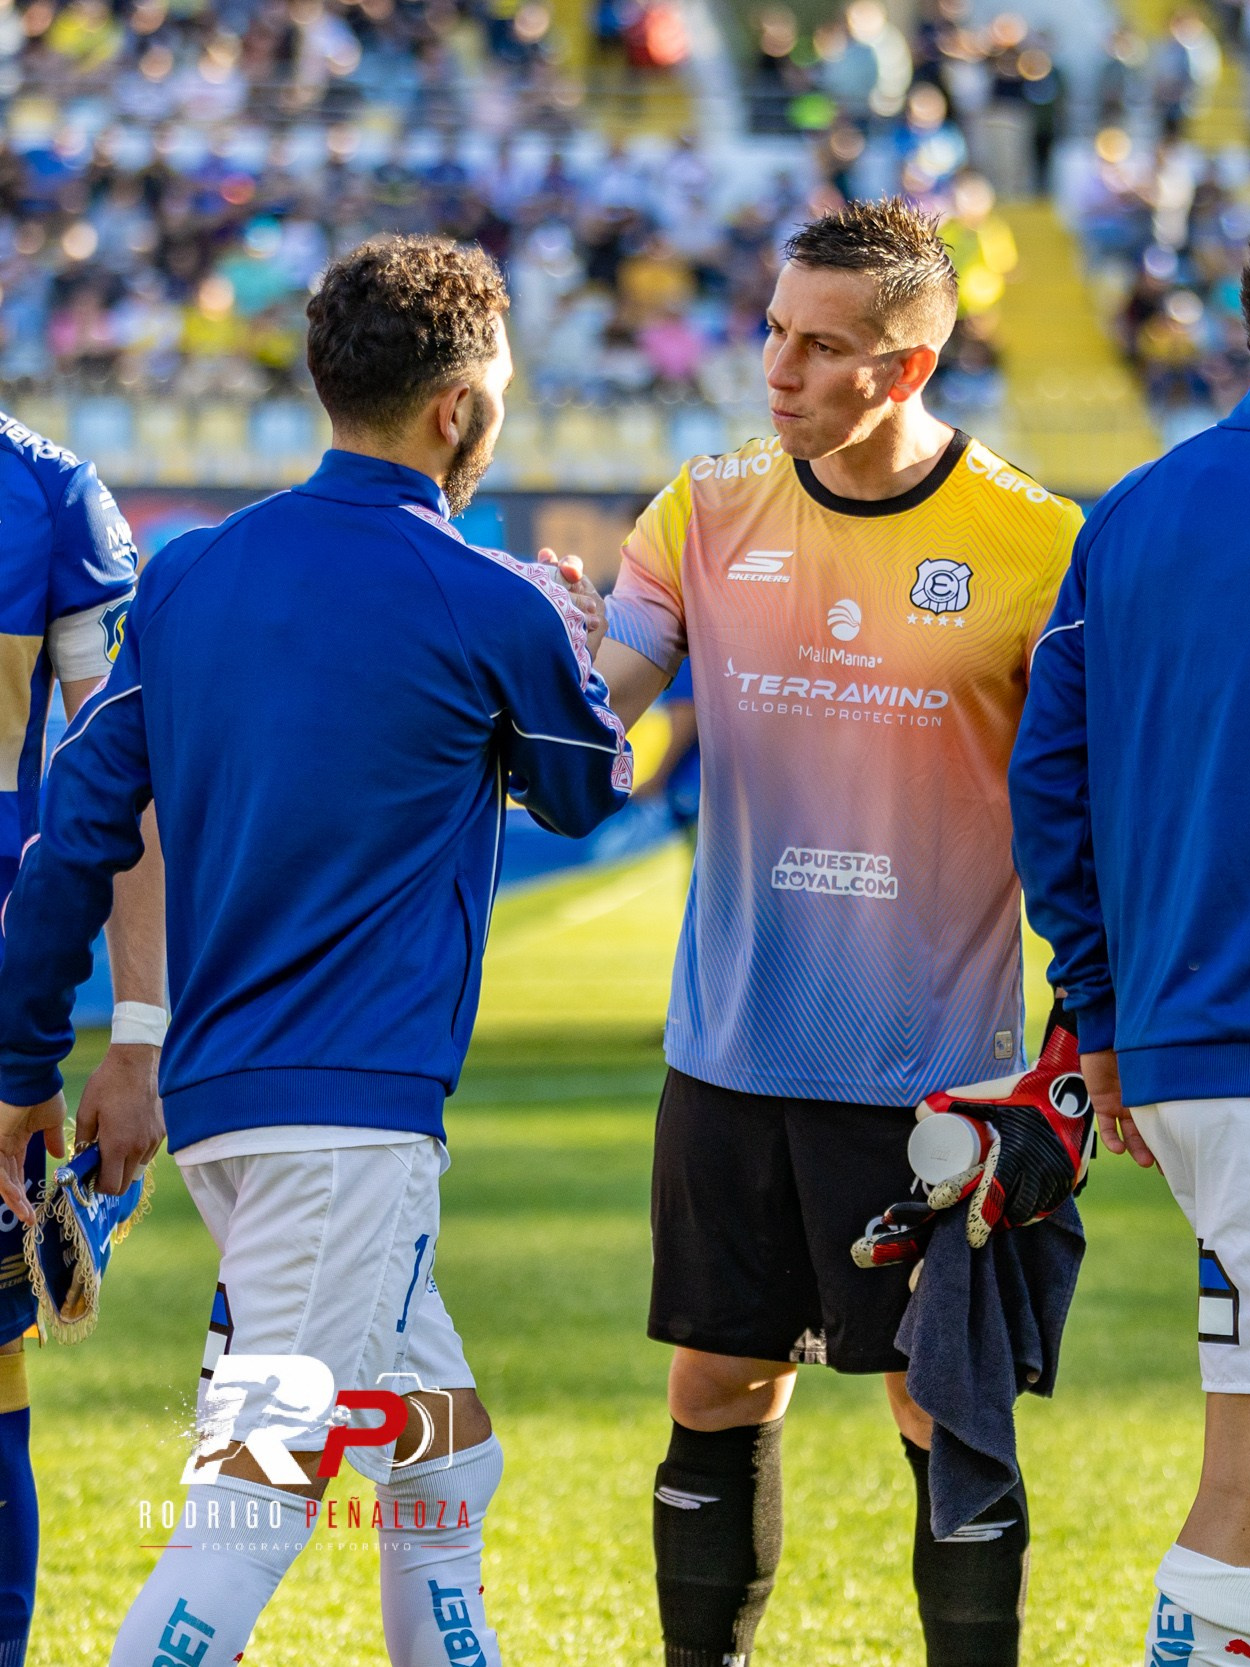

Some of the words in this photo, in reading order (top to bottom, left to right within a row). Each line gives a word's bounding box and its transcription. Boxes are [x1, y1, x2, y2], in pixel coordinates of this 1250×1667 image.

[0, 411, 61, 459] laro
[691, 453, 771, 482] Claro
[966, 446, 1049, 503] Claro
[727, 572, 791, 583] SKECHERS
[737, 673, 949, 709] TERRAWIND
[738, 700, 813, 716] GLOBAL
[824, 708, 942, 727] PROTECTION
[783, 850, 889, 875] APUESTAS
[774, 870, 896, 896] ROYAL.COM
